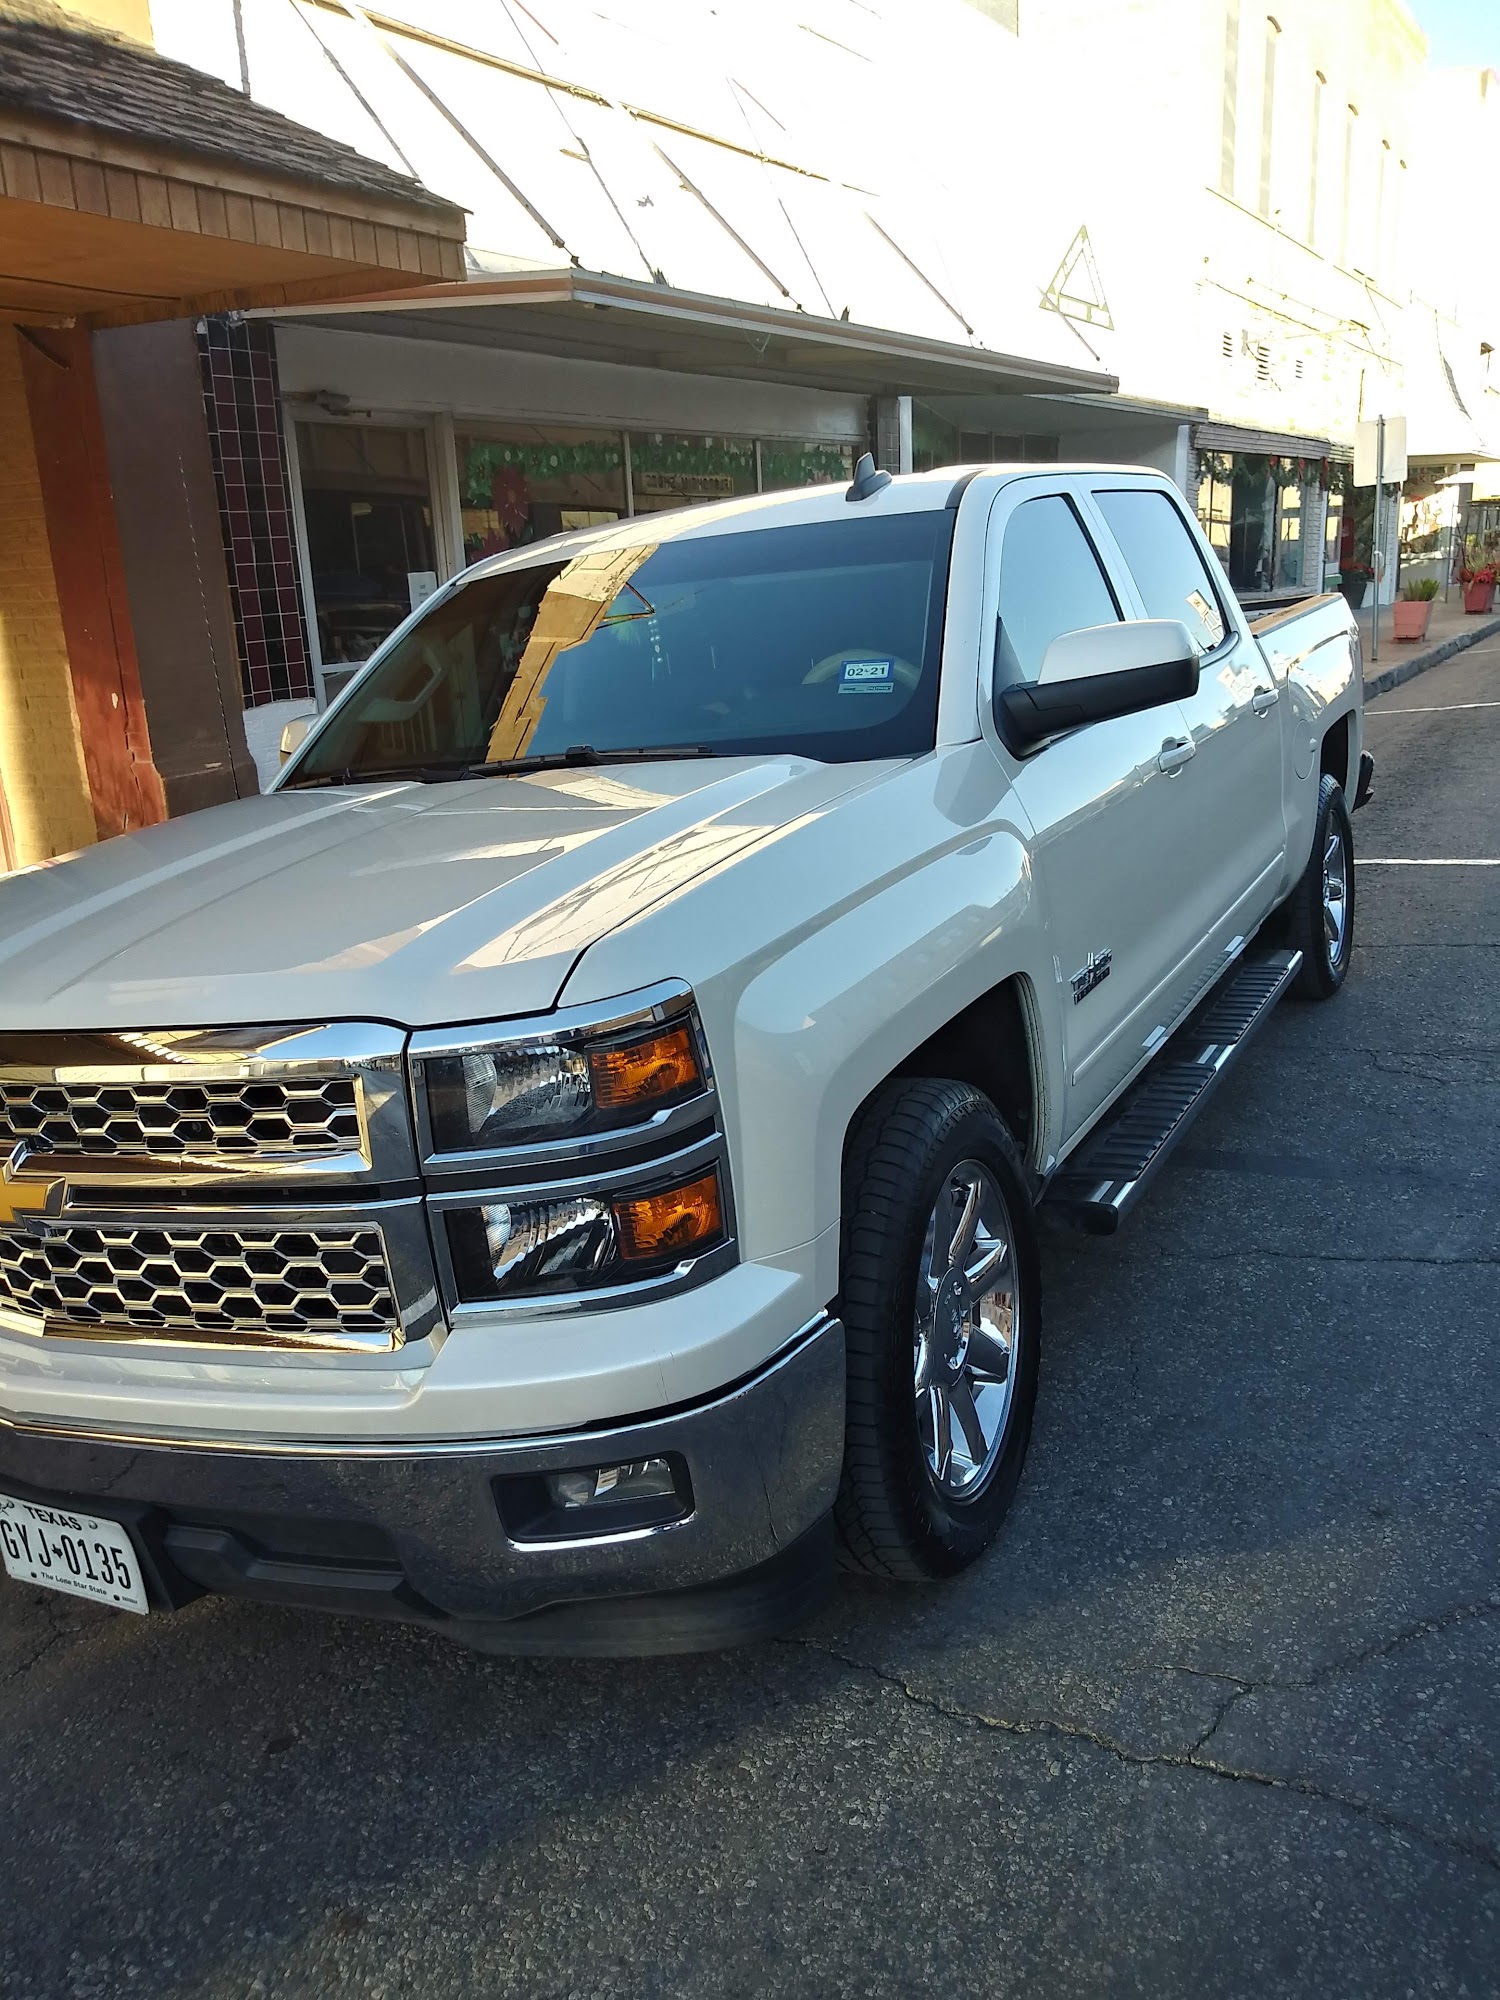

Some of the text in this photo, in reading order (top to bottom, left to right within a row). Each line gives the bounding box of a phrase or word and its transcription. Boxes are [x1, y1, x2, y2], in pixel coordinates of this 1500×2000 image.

[23, 1504, 82, 1531] TEXAS
[41, 1571, 107, 1595] The Lone Star State
